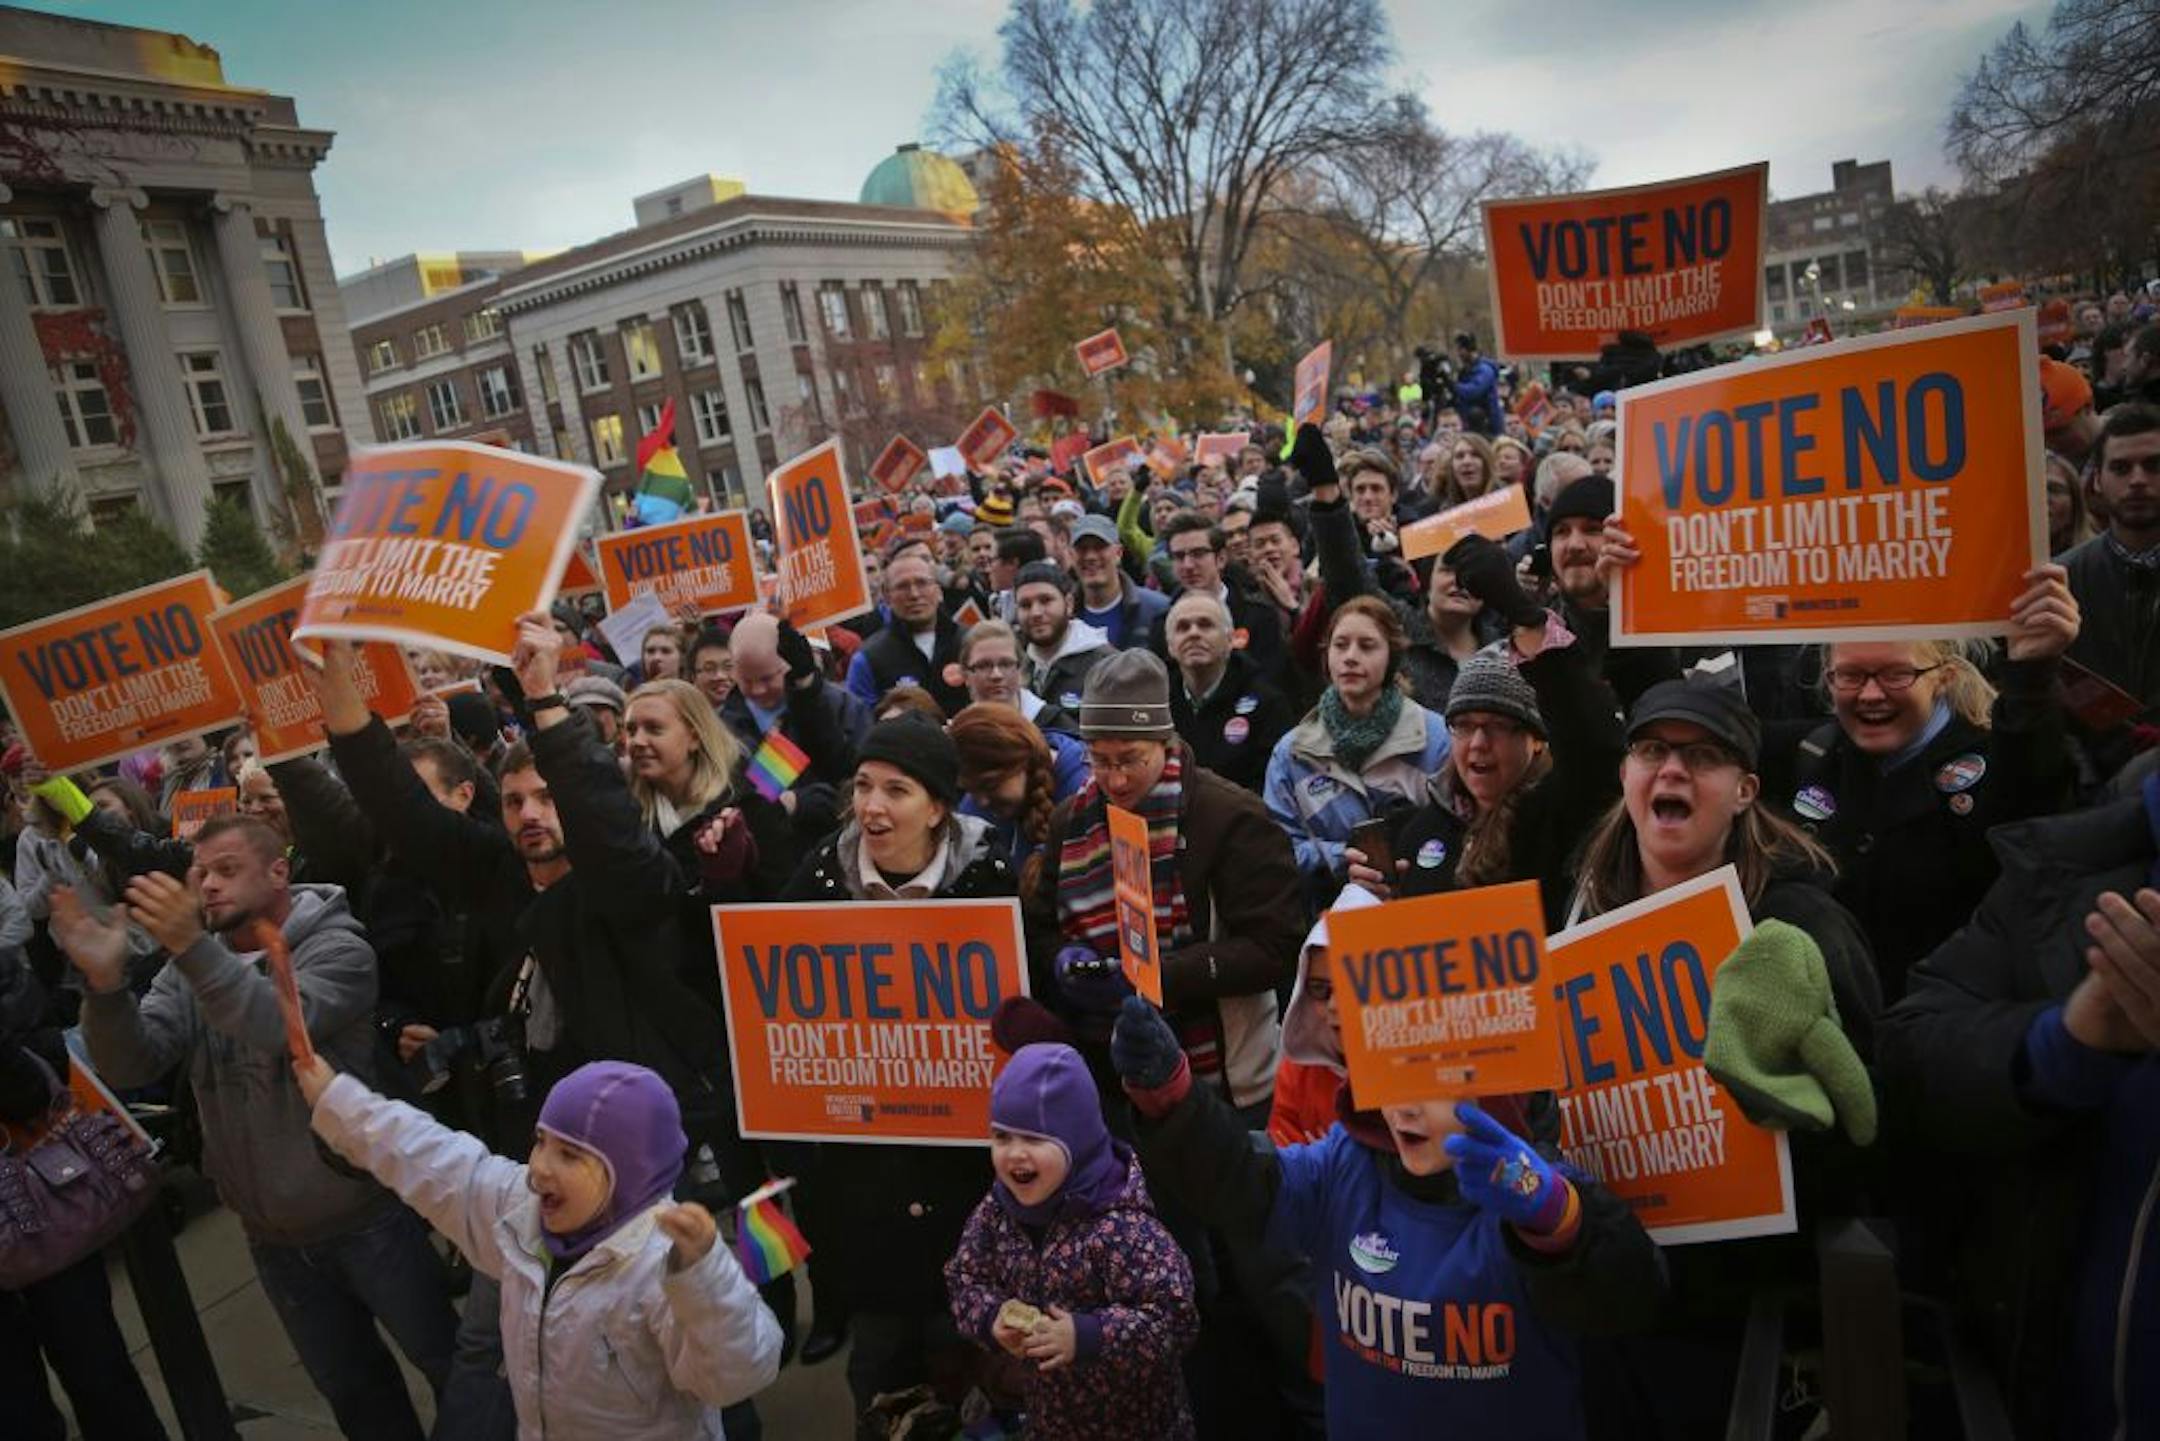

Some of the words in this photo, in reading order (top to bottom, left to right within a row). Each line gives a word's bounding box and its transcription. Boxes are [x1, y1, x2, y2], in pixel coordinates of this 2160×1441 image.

[1519, 211, 1654, 281] VOTE
[1663, 196, 1732, 269] NO
[1537, 279, 1604, 310] DON'T
[1610, 271, 1676, 307] LIMIT
[1678, 262, 1722, 296] THE
[1540, 305, 1628, 332] FREEDOM
[1632, 303, 1655, 327] TO
[1659, 290, 1721, 321] MARRY
[1653, 394, 1827, 510] VOTE
[1841, 371, 1967, 490] NO
[434, 471, 538, 550] NO
[784, 476, 831, 546] NO
[1667, 508, 1758, 558] DON'T
[1764, 495, 1863, 550] LIMIT
[1866, 487, 1952, 541] THE
[357, 537, 442, 574] LIMIT
[437, 544, 504, 587] THE
[614, 535, 688, 582] VOTE
[689, 528, 732, 566] NO
[800, 538, 834, 576] THE
[1670, 550, 1789, 592] FREEDOM
[1795, 547, 1830, 584] TO
[1836, 538, 1952, 582] MARRY
[369, 568, 397, 598] TO
[397, 573, 491, 612] MARRY
[18, 621, 141, 701] VOTE
[134, 603, 203, 666] NO
[51, 687, 113, 725] DON'T
[112, 671, 164, 707] LIMIT
[164, 657, 204, 690] THE
[60, 706, 140, 743] FREEDOM
[138, 698, 162, 721] TO
[159, 677, 212, 714] MARRY
[742, 942, 901, 1020] VOTE
[910, 940, 999, 1019] NO
[1343, 939, 1467, 1006] VOTE
[1470, 928, 1540, 990] NO
[1361, 1000, 1427, 1031] DON'T
[1430, 992, 1489, 1025] LIMIT
[1489, 986, 1537, 1019] THE
[1365, 1022, 1450, 1051] FREEDOM
[1452, 1018, 1473, 1041] TO
[1475, 1010, 1537, 1037] MARRY
[1610, 940, 1712, 1075] NO
[765, 1022, 848, 1059] DON'T
[854, 1023, 932, 1059] LIMIT
[936, 1023, 995, 1060] THE
[769, 1057, 878, 1087] FREEDOM
[880, 1059, 908, 1087] TO
[914, 1060, 994, 1088] MARRY
[1574, 1079, 1653, 1142] LIMIT
[1653, 1066, 1724, 1127] THE
[1603, 1139, 1638, 1183] TO
[1636, 1120, 1726, 1177] MARRY
[1333, 1270, 1436, 1363] VOTE
[1444, 1302, 1516, 1366] NO
[1402, 1359, 1455, 1380] FREEDOM
